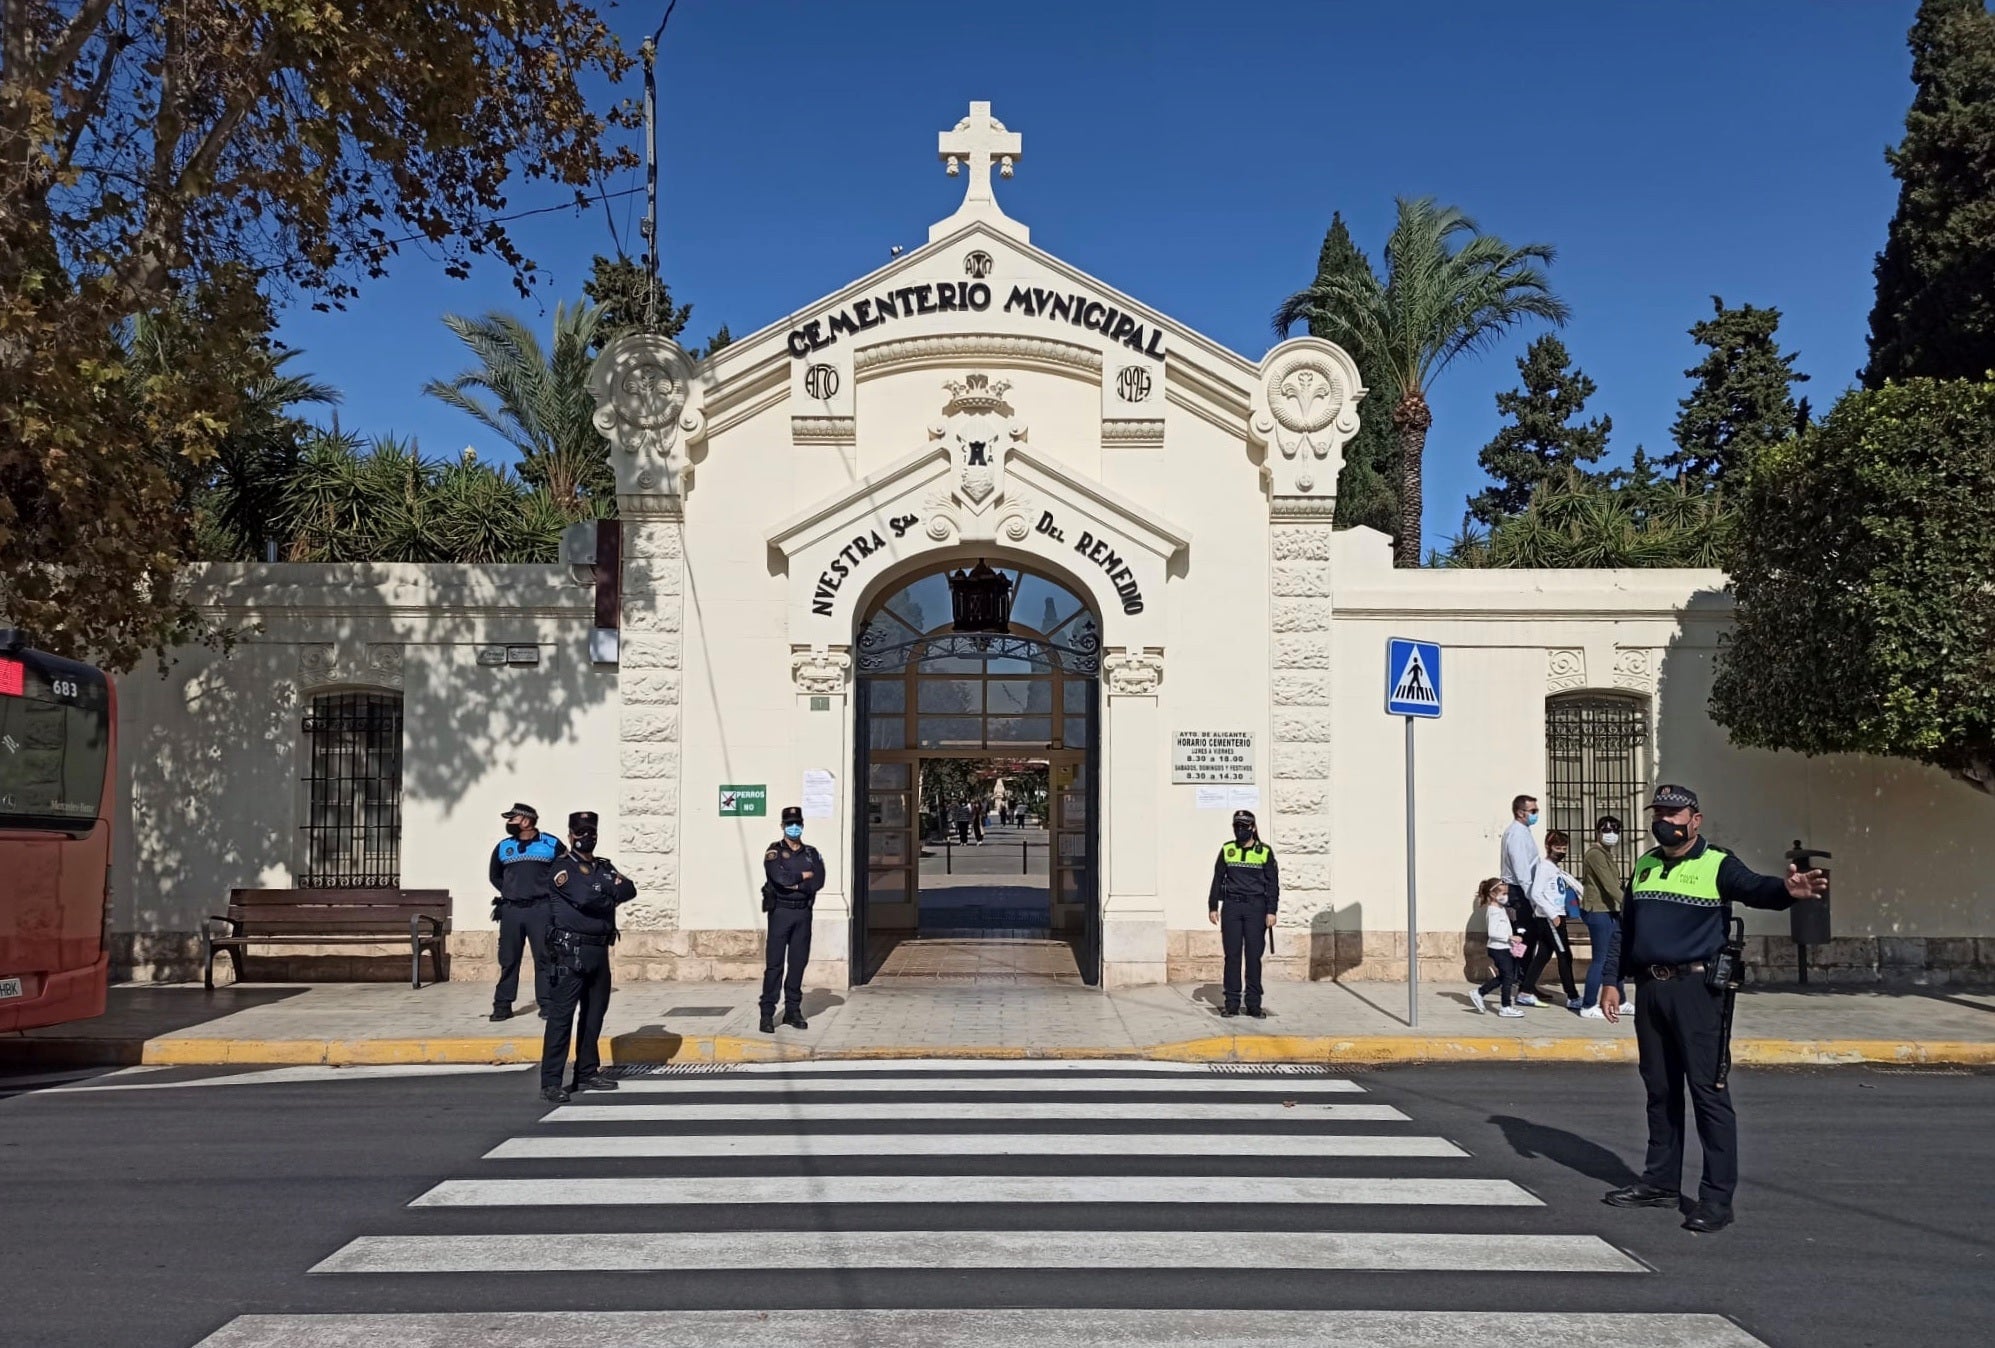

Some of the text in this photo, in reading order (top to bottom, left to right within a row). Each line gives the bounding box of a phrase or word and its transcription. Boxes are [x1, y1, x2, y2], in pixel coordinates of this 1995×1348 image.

[787, 282, 1166, 362] CEMENTERIO MVNICIPAL
[812, 531, 886, 617] NVESTRA
[1075, 531, 1144, 616] REMEDIO
[53, 680, 78, 698] 683
[1177, 738, 1251, 747] HORARIO CEMENTERIO
[736, 791, 765, 799] PERROS
